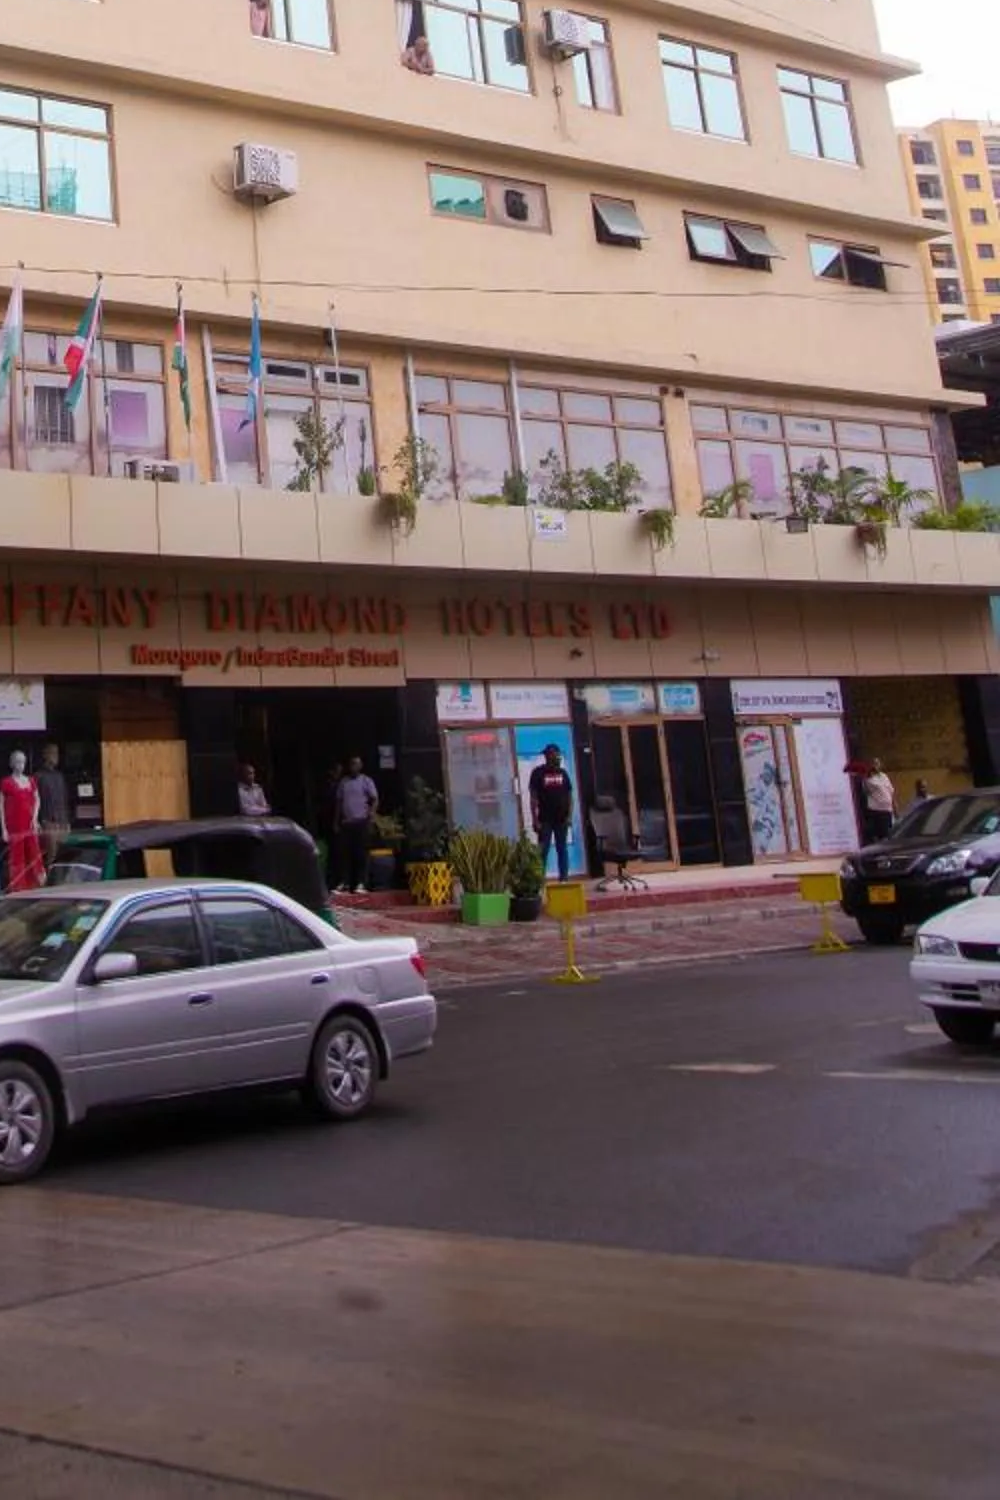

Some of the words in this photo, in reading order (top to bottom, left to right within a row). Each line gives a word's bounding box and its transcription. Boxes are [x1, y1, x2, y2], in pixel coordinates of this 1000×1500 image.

[203, 587, 409, 637] DIAMOND
[439, 596, 594, 639] HOTELS
[609, 601, 672, 641] LTD
